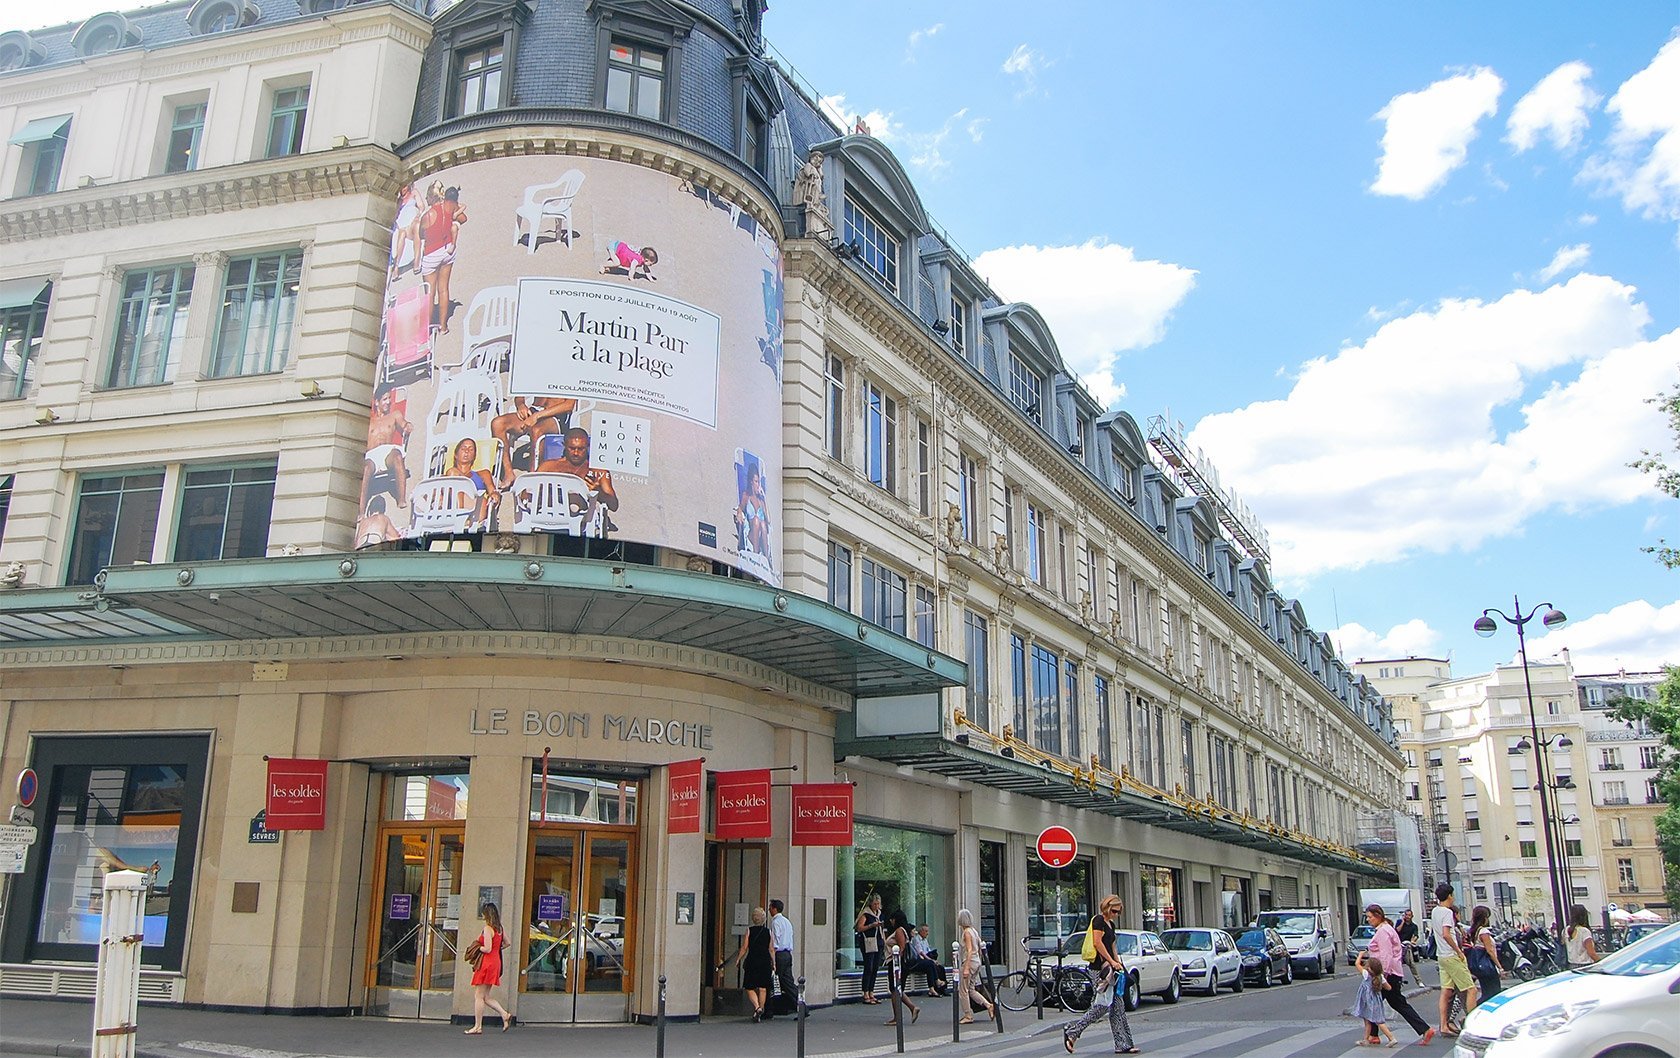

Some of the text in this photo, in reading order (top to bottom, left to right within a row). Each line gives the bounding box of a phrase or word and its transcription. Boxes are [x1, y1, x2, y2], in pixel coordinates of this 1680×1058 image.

[549, 289, 602, 300] EXPOSITION
[603, 294, 616, 302] DU
[624, 297, 656, 310] JUILLET
[656, 305, 668, 313] AU
[679, 311, 698, 324] AOÛT
[559, 309, 689, 355] Martin Parr
[571, 340, 674, 380] à la plage
[559, 384, 618, 398] COLLABORATION
[618, 391, 637, 401] AVEC
[637, 394, 665, 407] MAGNUM
[665, 401, 690, 413] PHOTOS
[578, 379, 666, 399] PHOTOGRAPHIES INÉDITES
[587, 470, 649, 485] RIVE GAUCHE
[469, 708, 714, 751] LE BON MARCHE
[272, 783, 321, 798] les soldes
[671, 785, 698, 802] les soldes
[721, 794, 766, 809] les soldes
[798, 805, 847, 818] les soldes
